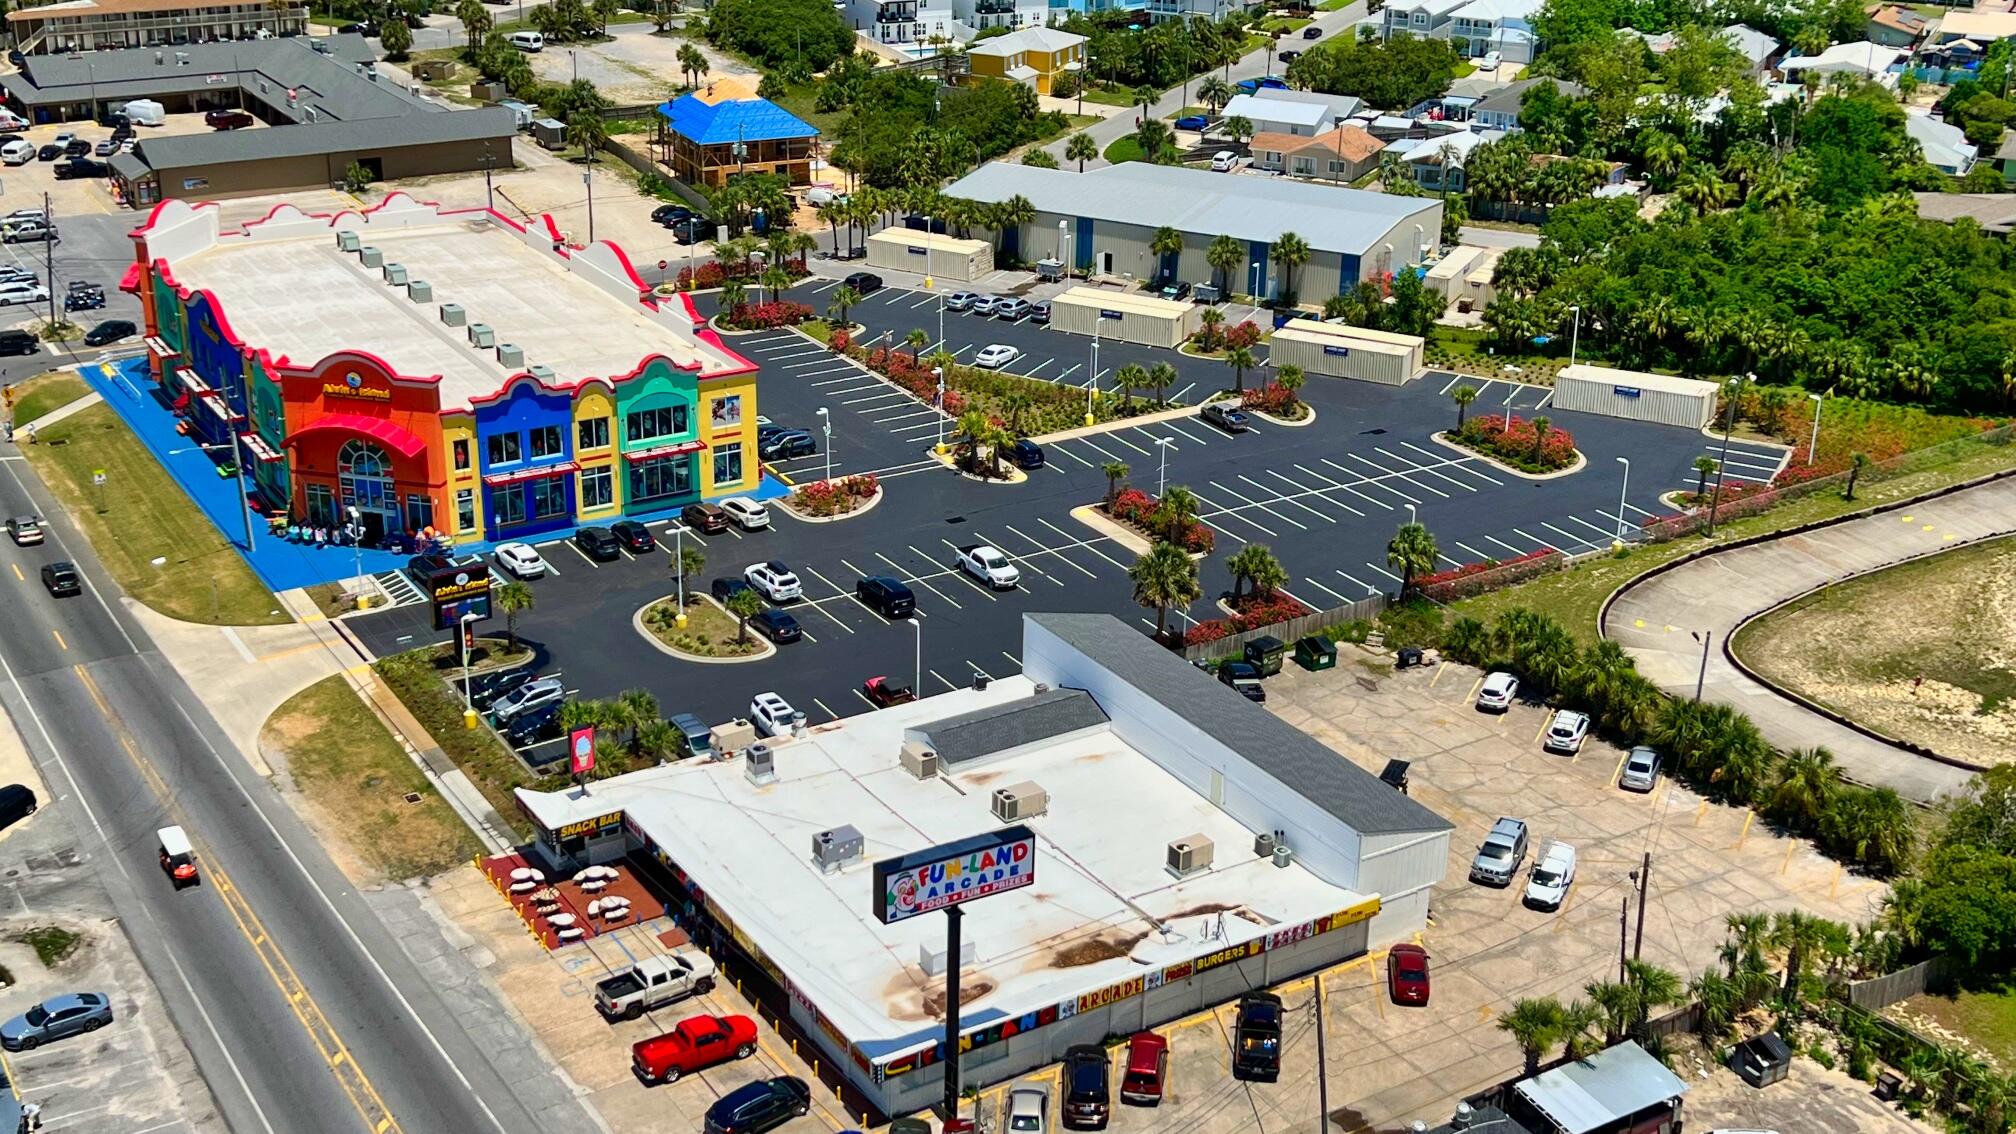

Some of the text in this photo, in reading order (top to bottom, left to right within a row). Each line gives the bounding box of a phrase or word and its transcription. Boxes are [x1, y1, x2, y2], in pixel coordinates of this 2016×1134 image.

[560, 819, 597, 837] SNACK
[600, 812, 622, 827] BAR
[918, 842, 1028, 887] FUN-LAND
[927, 864, 1020, 899] ARCADE
[921, 874, 1028, 910] FOOD FUN PRIZES
[1196, 945, 1245, 970] BURGERS
[1079, 977, 1142, 1011] ARCADE
